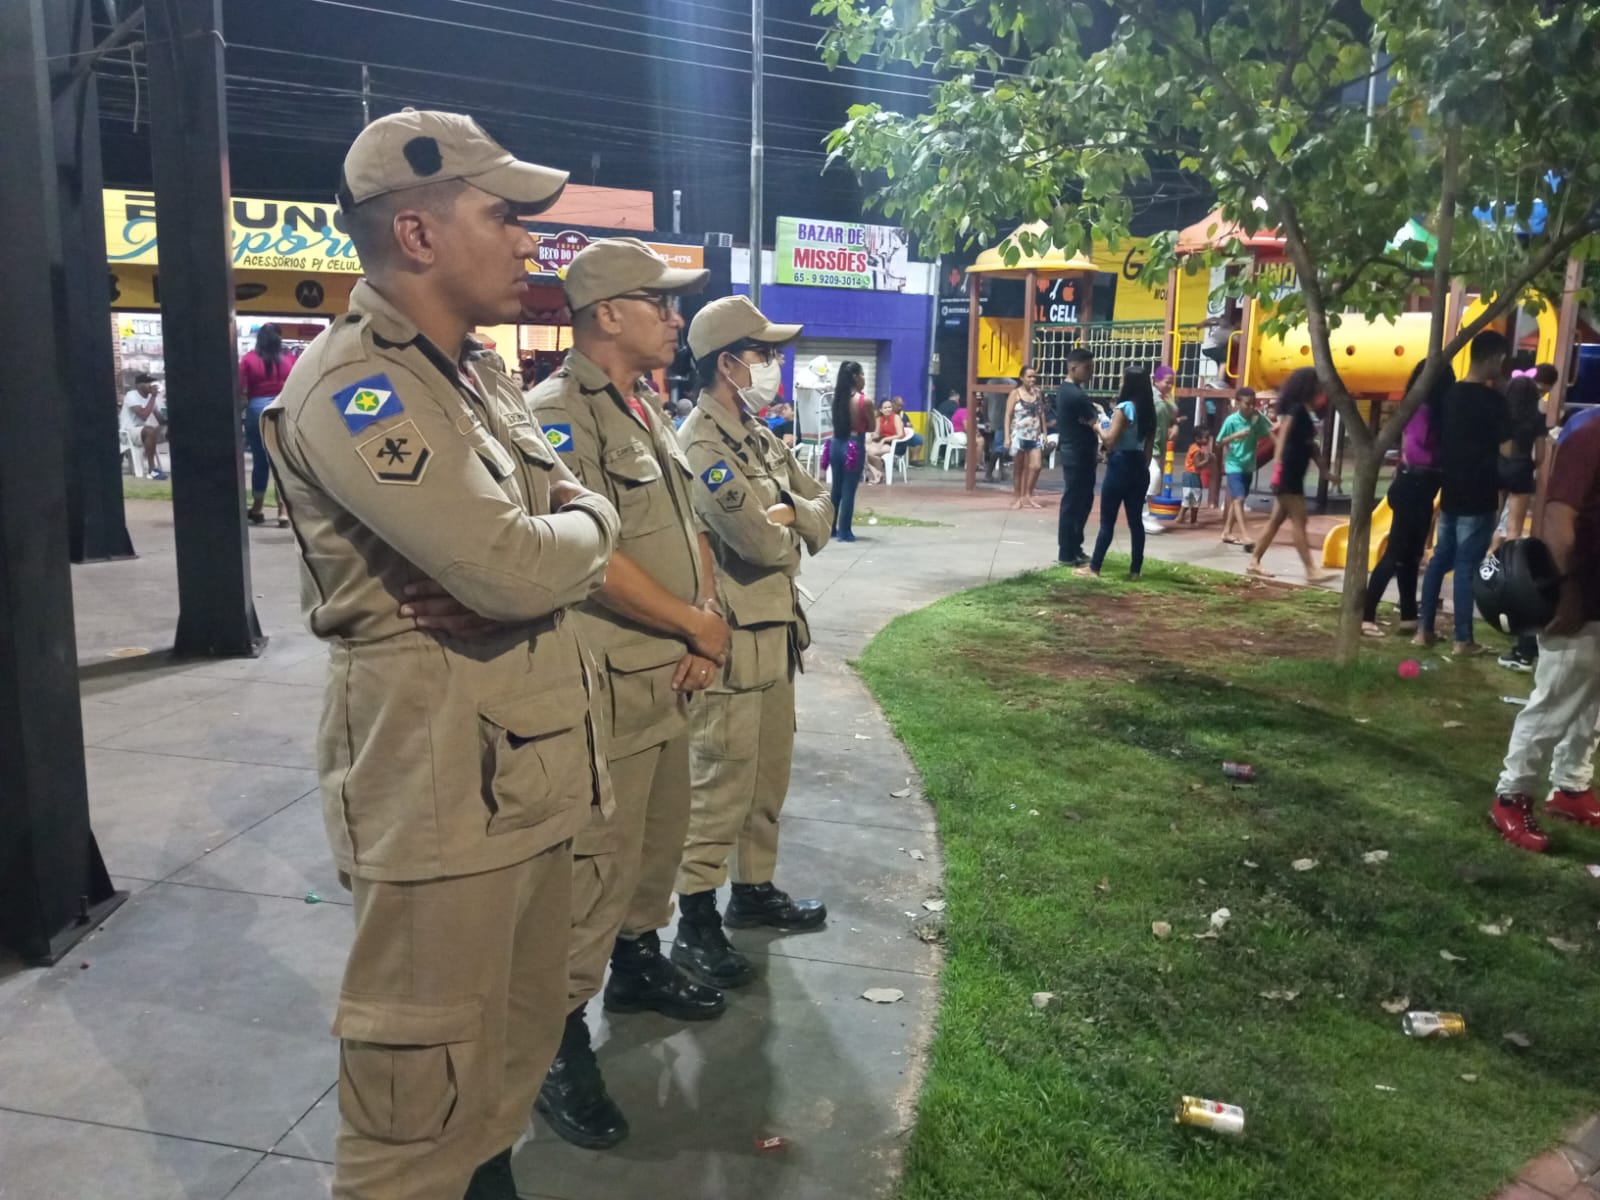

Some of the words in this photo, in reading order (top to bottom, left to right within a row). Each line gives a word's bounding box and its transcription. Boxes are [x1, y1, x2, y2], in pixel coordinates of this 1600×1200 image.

[798, 223, 844, 244] BAZAR
[847, 228, 865, 246] DE
[538, 246, 560, 261] BECO
[560, 249, 572, 261] DO
[794, 247, 867, 273] MISSÕES
[243, 255, 307, 270] ACESSÓRIOS
[312, 258, 324, 271] P/
[794, 273, 804, 283] 65
[812, 274, 817, 284] 9
[820, 275, 862, 286] 9209-3014
[1049, 304, 1078, 323] CELL
